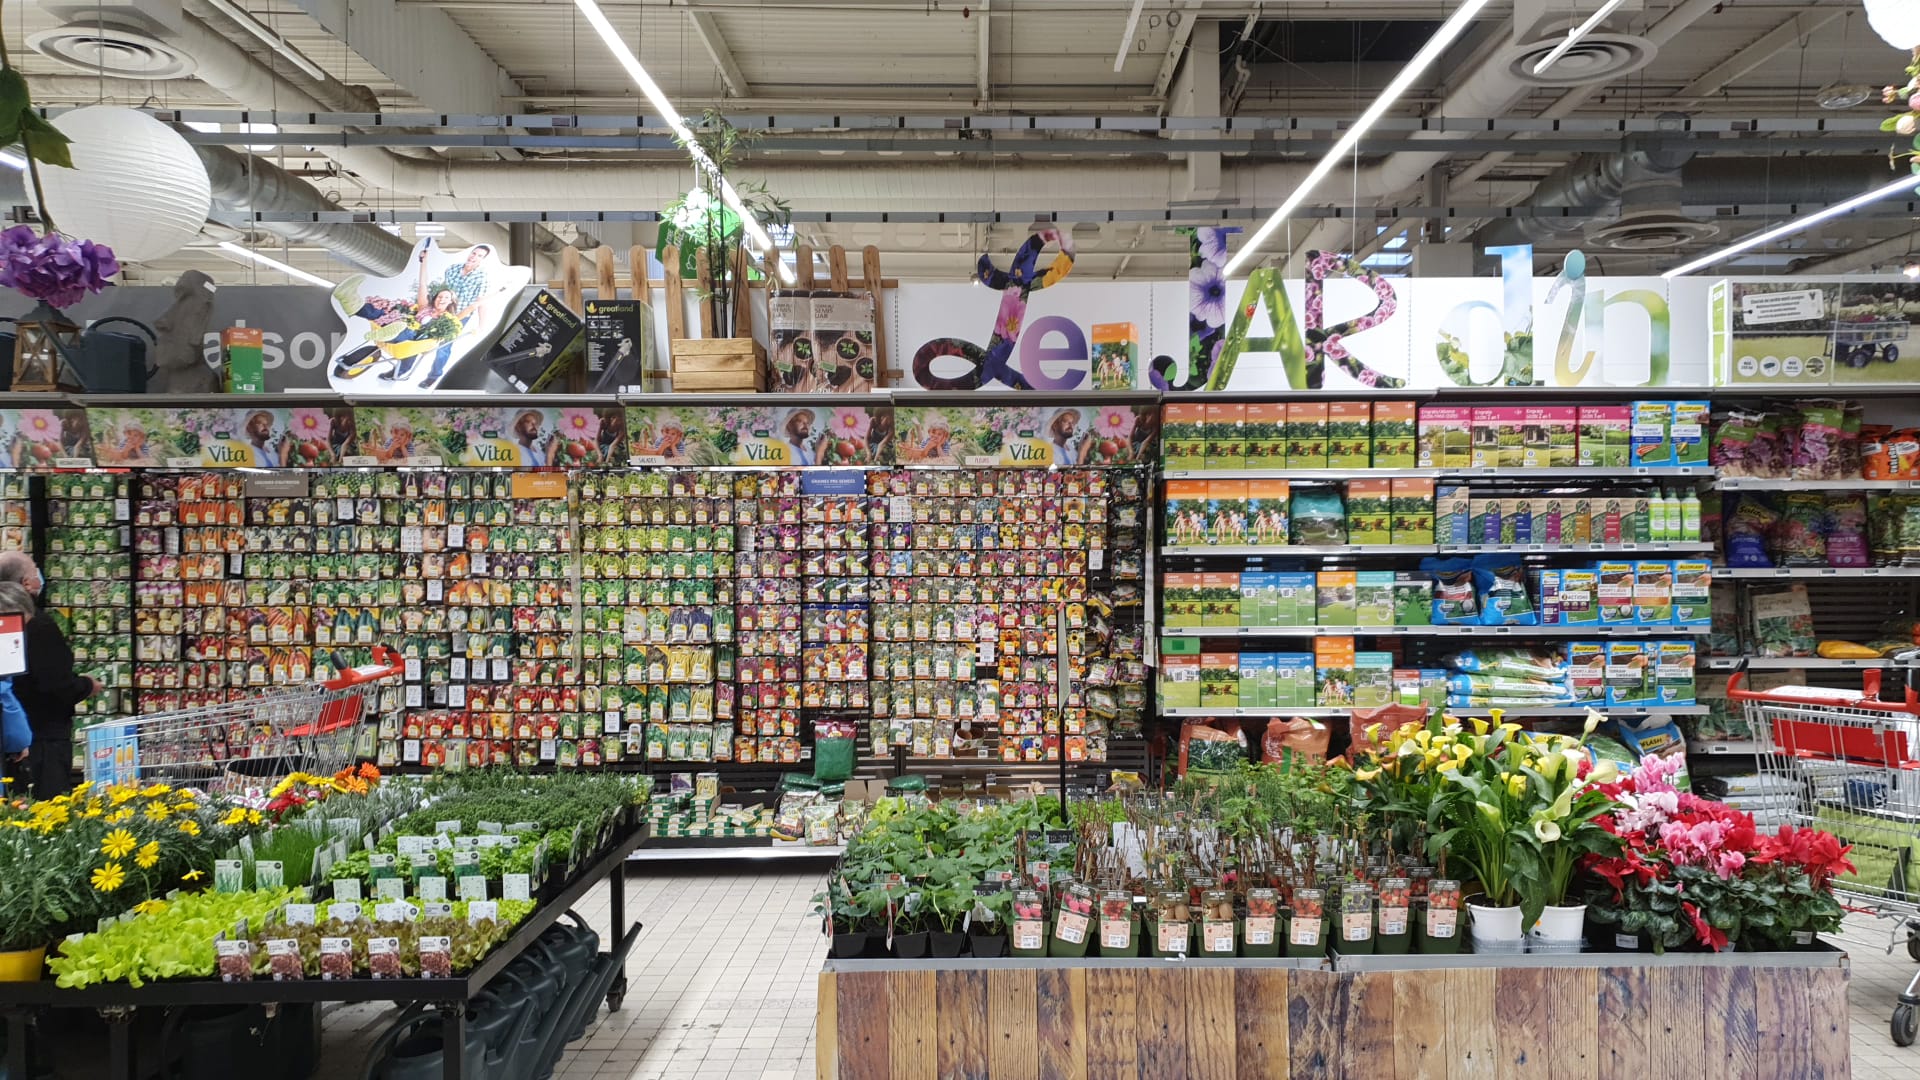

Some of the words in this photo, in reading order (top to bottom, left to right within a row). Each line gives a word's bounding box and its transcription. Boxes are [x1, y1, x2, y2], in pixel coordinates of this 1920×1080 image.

[545, 303, 578, 329] greatland
[598, 303, 634, 314] greatland
[913, 228, 1088, 391] Le
[207, 443, 248, 463] Vita
[474, 443, 514, 462] Vita
[744, 442, 784, 461] Vita
[1008, 442, 1047, 461] Vita
